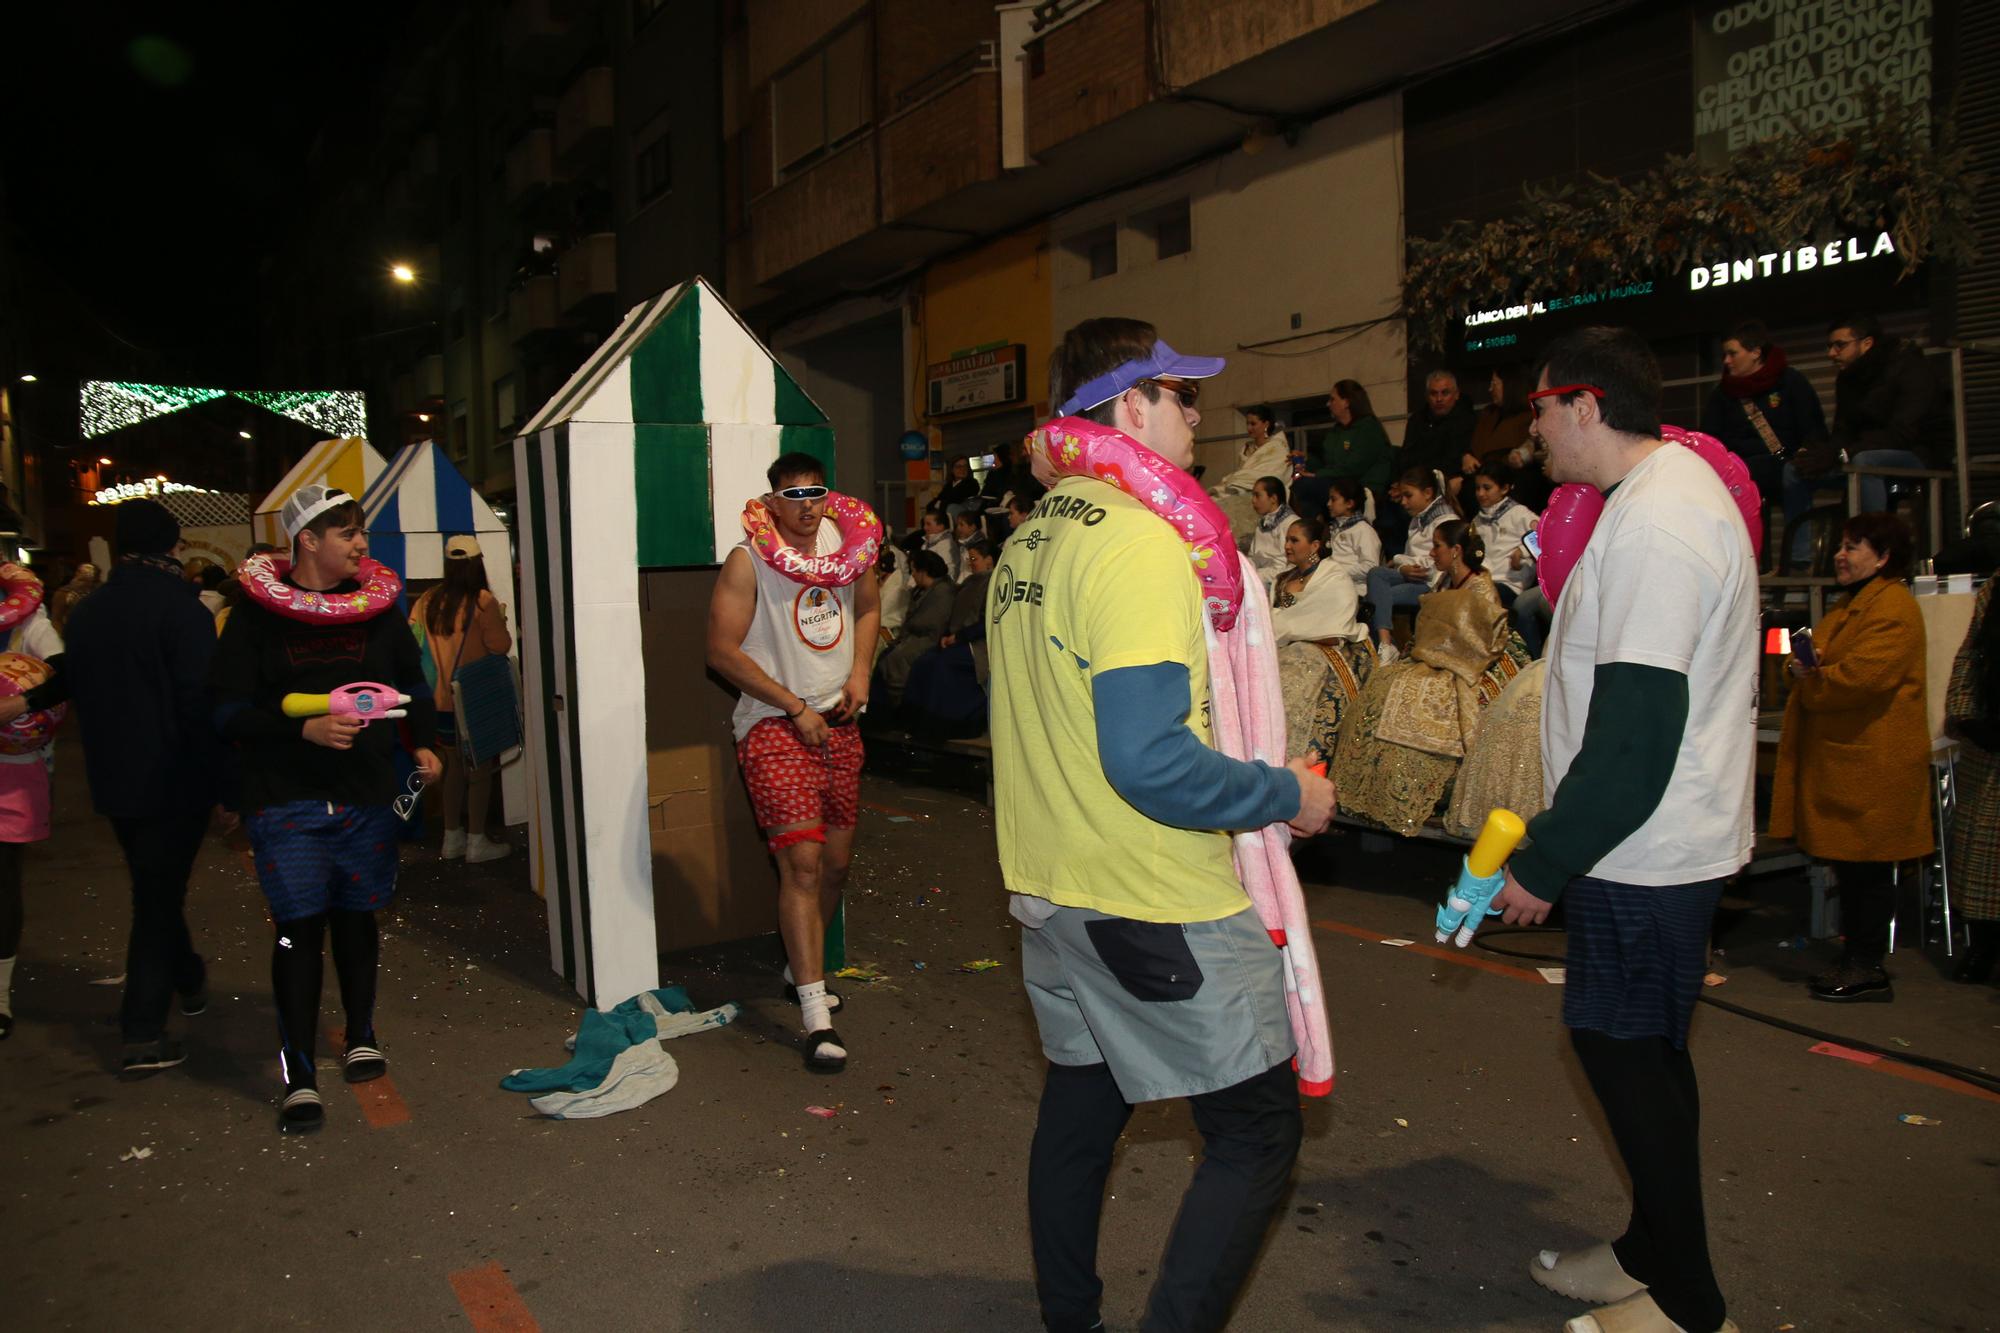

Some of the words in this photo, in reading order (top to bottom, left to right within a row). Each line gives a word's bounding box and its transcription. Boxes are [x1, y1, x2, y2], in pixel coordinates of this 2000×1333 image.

[1727, 0, 1933, 77] ORTODONCIA
[1822, 20, 1933, 76] BUCAL
[1696, 47, 1933, 136] IMPLANTOLOGIA
[1505, 301, 1547, 320] DENAL
[800, 610, 840, 626] NEGRITA
